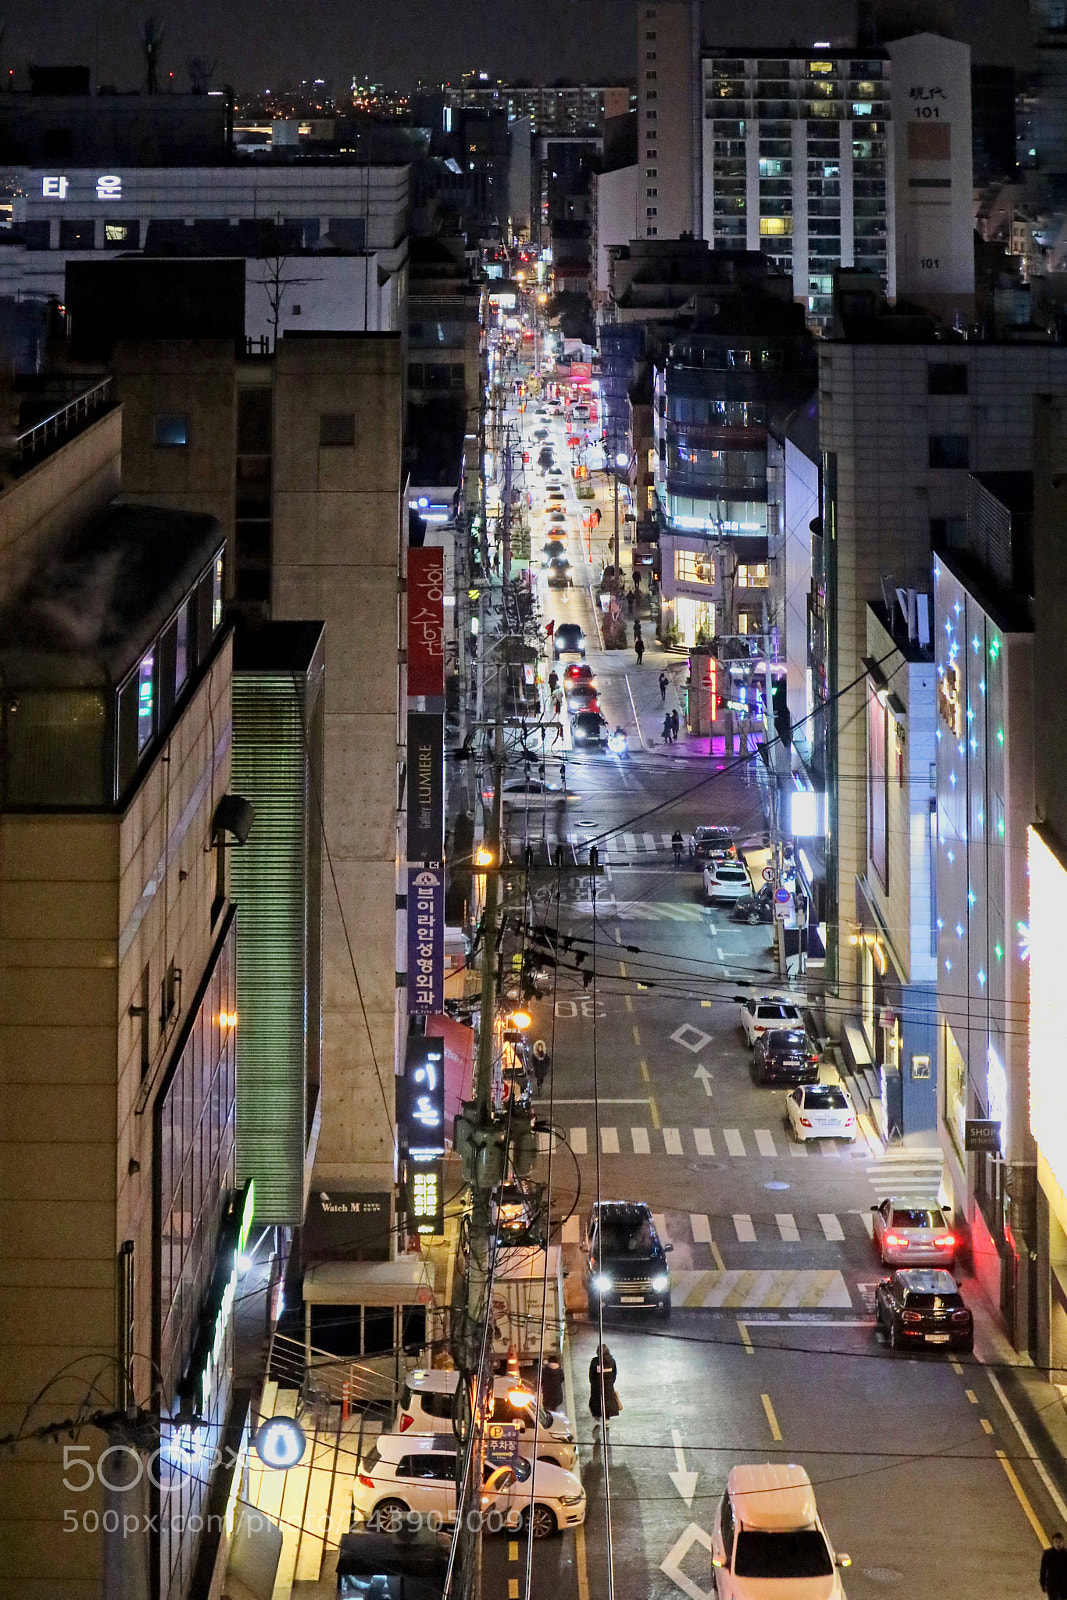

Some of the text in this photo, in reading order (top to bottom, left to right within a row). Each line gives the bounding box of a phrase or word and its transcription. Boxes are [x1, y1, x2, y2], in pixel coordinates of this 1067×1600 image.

[909, 87, 947, 100] 現代
[914, 107, 939, 118] 101
[920, 259, 940, 269] 101
[419, 744, 432, 804] LUMIERE
[416, 887, 435, 1005] 브이라인성형외과
[321, 1202, 348, 1212] Watch
[350, 1202, 361, 1212] M
[490, 1440, 517, 1451] 주차장
